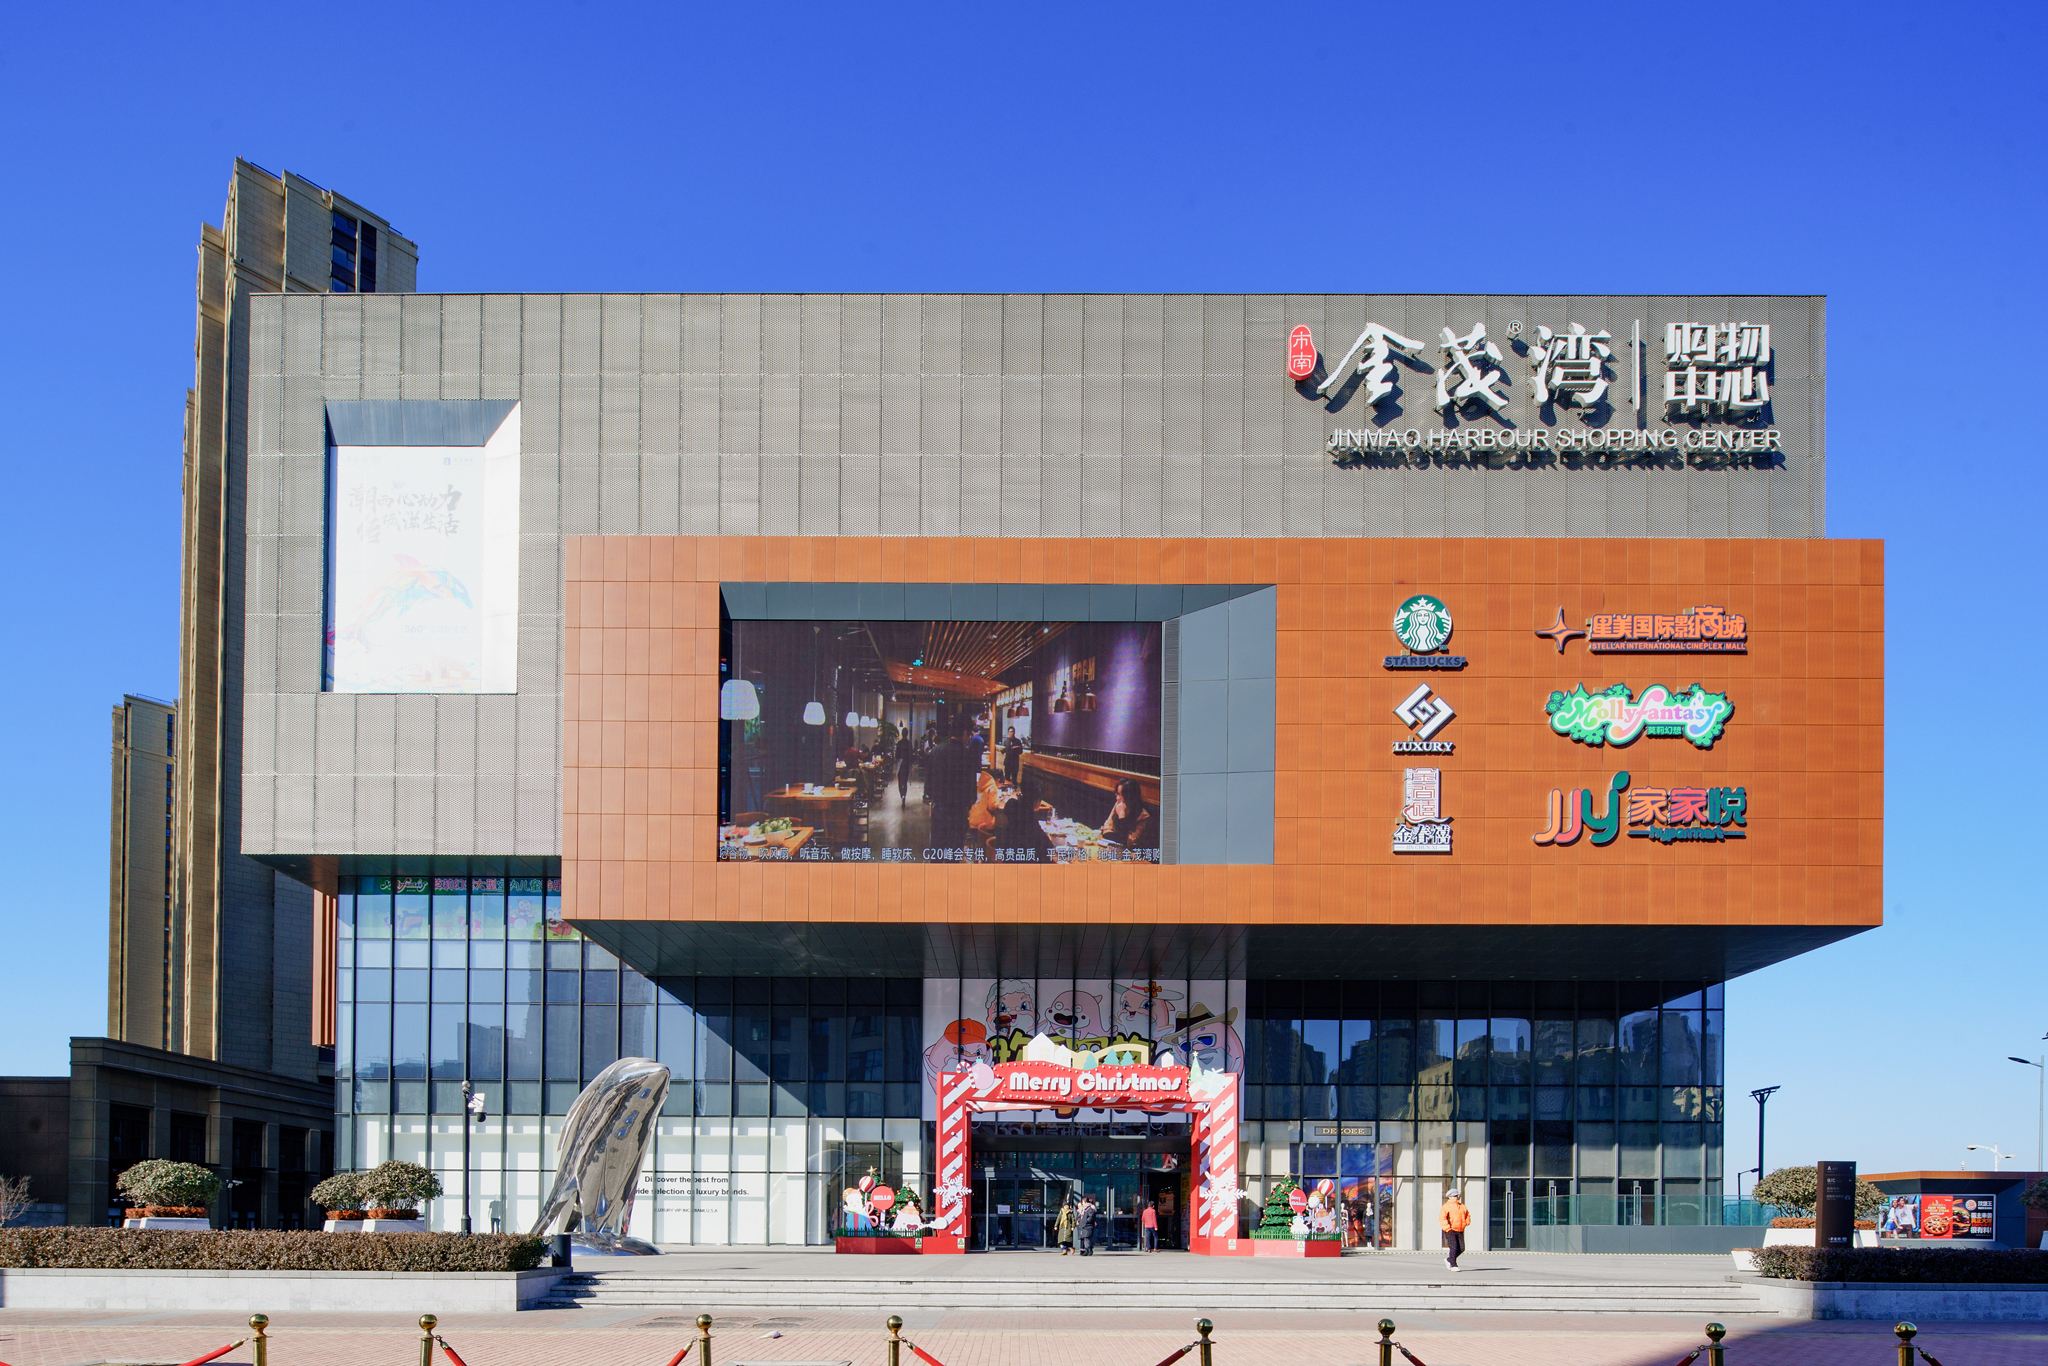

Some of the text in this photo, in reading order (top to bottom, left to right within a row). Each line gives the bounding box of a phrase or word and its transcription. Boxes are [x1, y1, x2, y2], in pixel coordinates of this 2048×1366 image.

[1667, 321, 1770, 365] 购物
[1667, 366, 1770, 411] 中心
[1327, 428, 1782, 448] JINMAO HARBOUR SHOPPING CENTER
[1592, 642, 1746, 650] STELLAR INTERNATIONAL CINEPLEX MALL
[1384, 656, 1463, 667] STARBUCKS
[1647, 726, 1682, 735] 莫莉幻想
[1393, 741, 1454, 752] LUXURY
[1630, 786, 1746, 823] 家家悦
[1650, 825, 1724, 841] hypermart
[1010, 1072, 1182, 1096] Merry Christmas
[696, 1188, 719, 1197] luxury
[721, 1188, 750, 1196] brnds.
